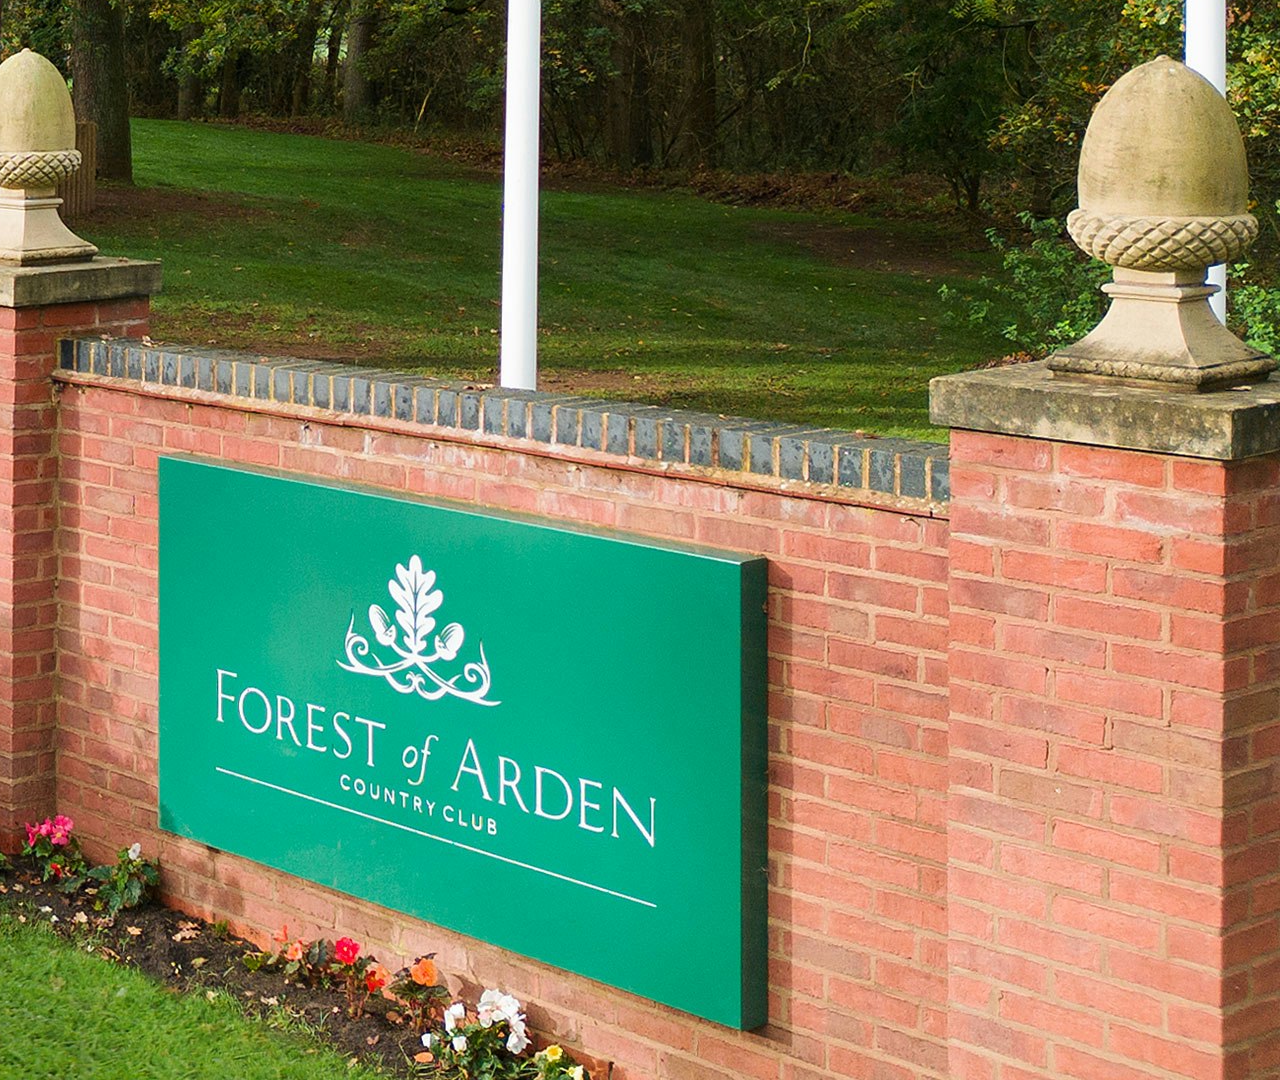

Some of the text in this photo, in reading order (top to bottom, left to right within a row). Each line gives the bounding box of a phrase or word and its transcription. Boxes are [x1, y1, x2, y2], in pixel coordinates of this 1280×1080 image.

[216, 668, 657, 848] FOREST of ARDEN
[339, 774, 498, 836] COUNTRY CLUB
